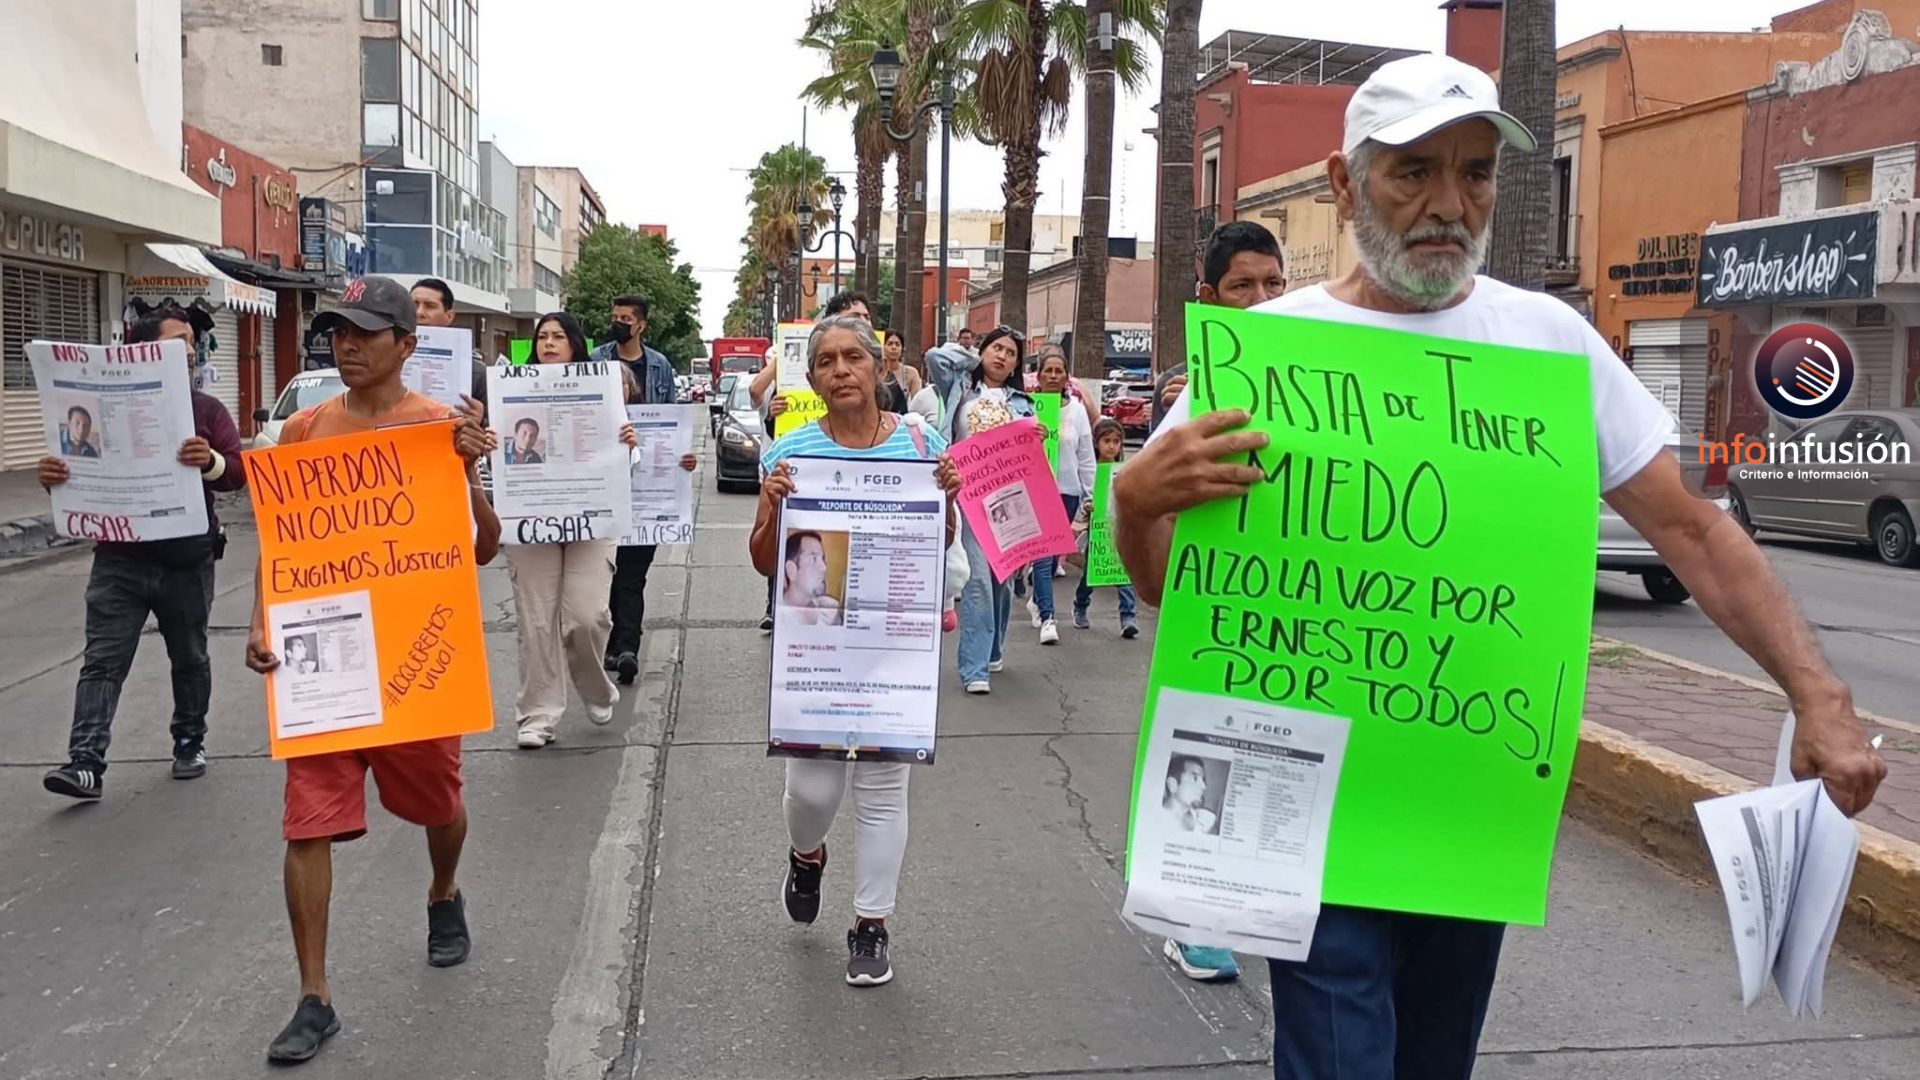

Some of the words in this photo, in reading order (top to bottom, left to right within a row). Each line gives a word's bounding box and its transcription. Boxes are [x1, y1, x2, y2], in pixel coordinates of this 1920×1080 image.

[1714, 233, 1844, 297] Barbershop
[52, 344, 89, 363] NOS
[501, 365, 539, 379] NOS
[1383, 391, 1425, 421] DE
[1425, 350, 1562, 467] TENER
[249, 452, 295, 505] NI
[863, 475, 902, 486] FGED
[1238, 450, 1448, 548] MIEDO
[276, 512, 304, 543] NI
[309, 491, 414, 540] OLVIDO
[853, 503, 862, 511] DE
[1173, 543, 1270, 599] ALZO
[1279, 557, 1322, 605] LA
[1336, 565, 1416, 615] VOZ
[1430, 576, 1523, 638] POR
[1210, 604, 1409, 671] ERNESTO
[1428, 634, 1454, 690] Y
[1192, 647, 1335, 709] POR
[1254, 722, 1292, 737] FGED
